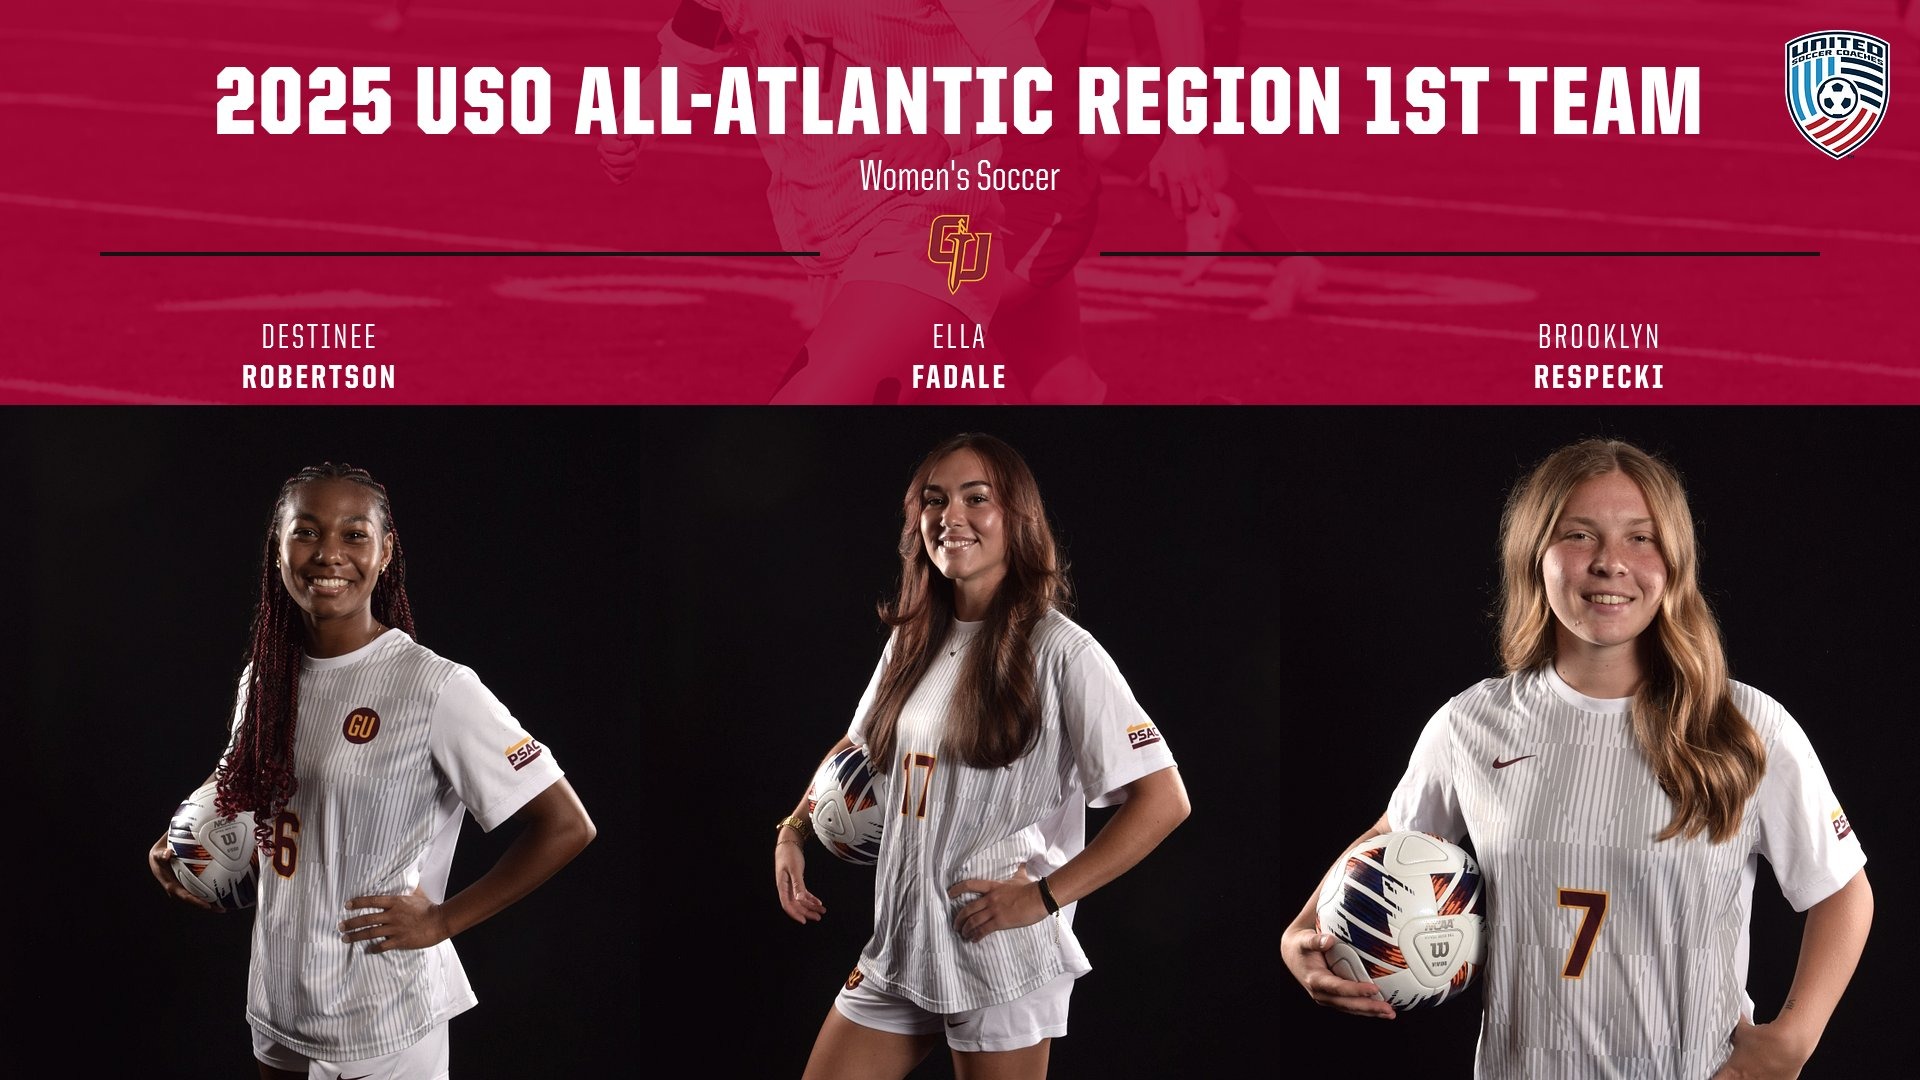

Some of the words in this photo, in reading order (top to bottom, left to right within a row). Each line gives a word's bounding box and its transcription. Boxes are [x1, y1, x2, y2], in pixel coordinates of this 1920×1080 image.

[348, 714, 376, 738] GU
[1128, 727, 1159, 744] PSAC
[507, 739, 541, 766] PSAC
[901, 753, 936, 819] 17
[1832, 814, 1848, 834] PS
[272, 811, 302, 880] 6
[1557, 888, 1609, 979] 7
